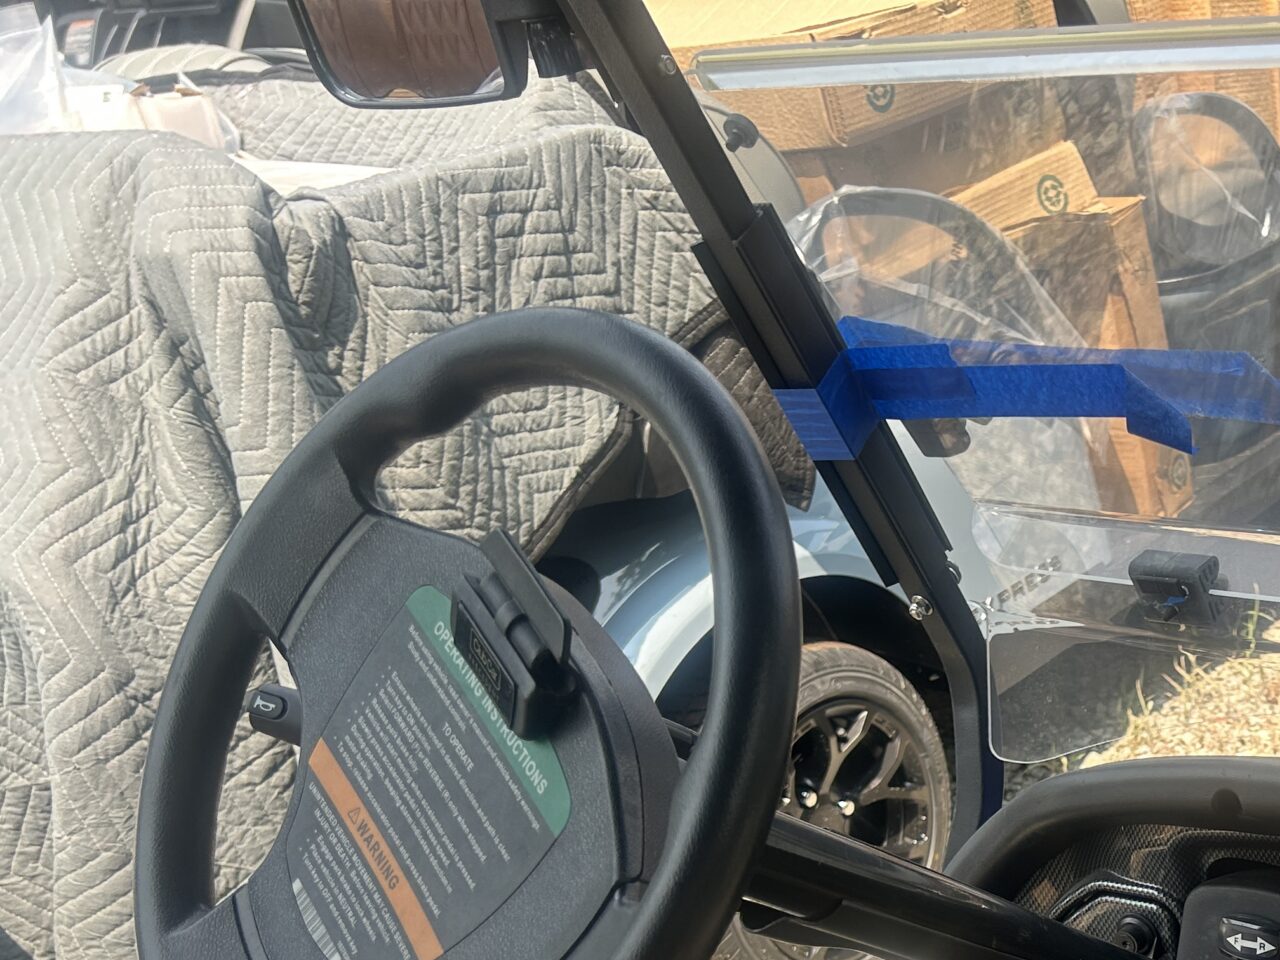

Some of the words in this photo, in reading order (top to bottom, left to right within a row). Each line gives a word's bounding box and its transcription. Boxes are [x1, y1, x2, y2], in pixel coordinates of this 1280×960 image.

[390, 707, 414, 744] FORWARD
[421, 757, 444, 792] REVERSE
[441, 721, 452, 737] TO
[448, 732, 474, 772] OPERATE
[313, 806, 331, 835] INJURY
[334, 823, 354, 856] VEHICLE
[351, 852, 376, 894] MOVEMENT
[372, 890, 385, 910] MAY
[380, 905, 398, 934] CAUSE
[355, 818, 400, 891] WARNING
[1259, 942, 1266, 951] R
